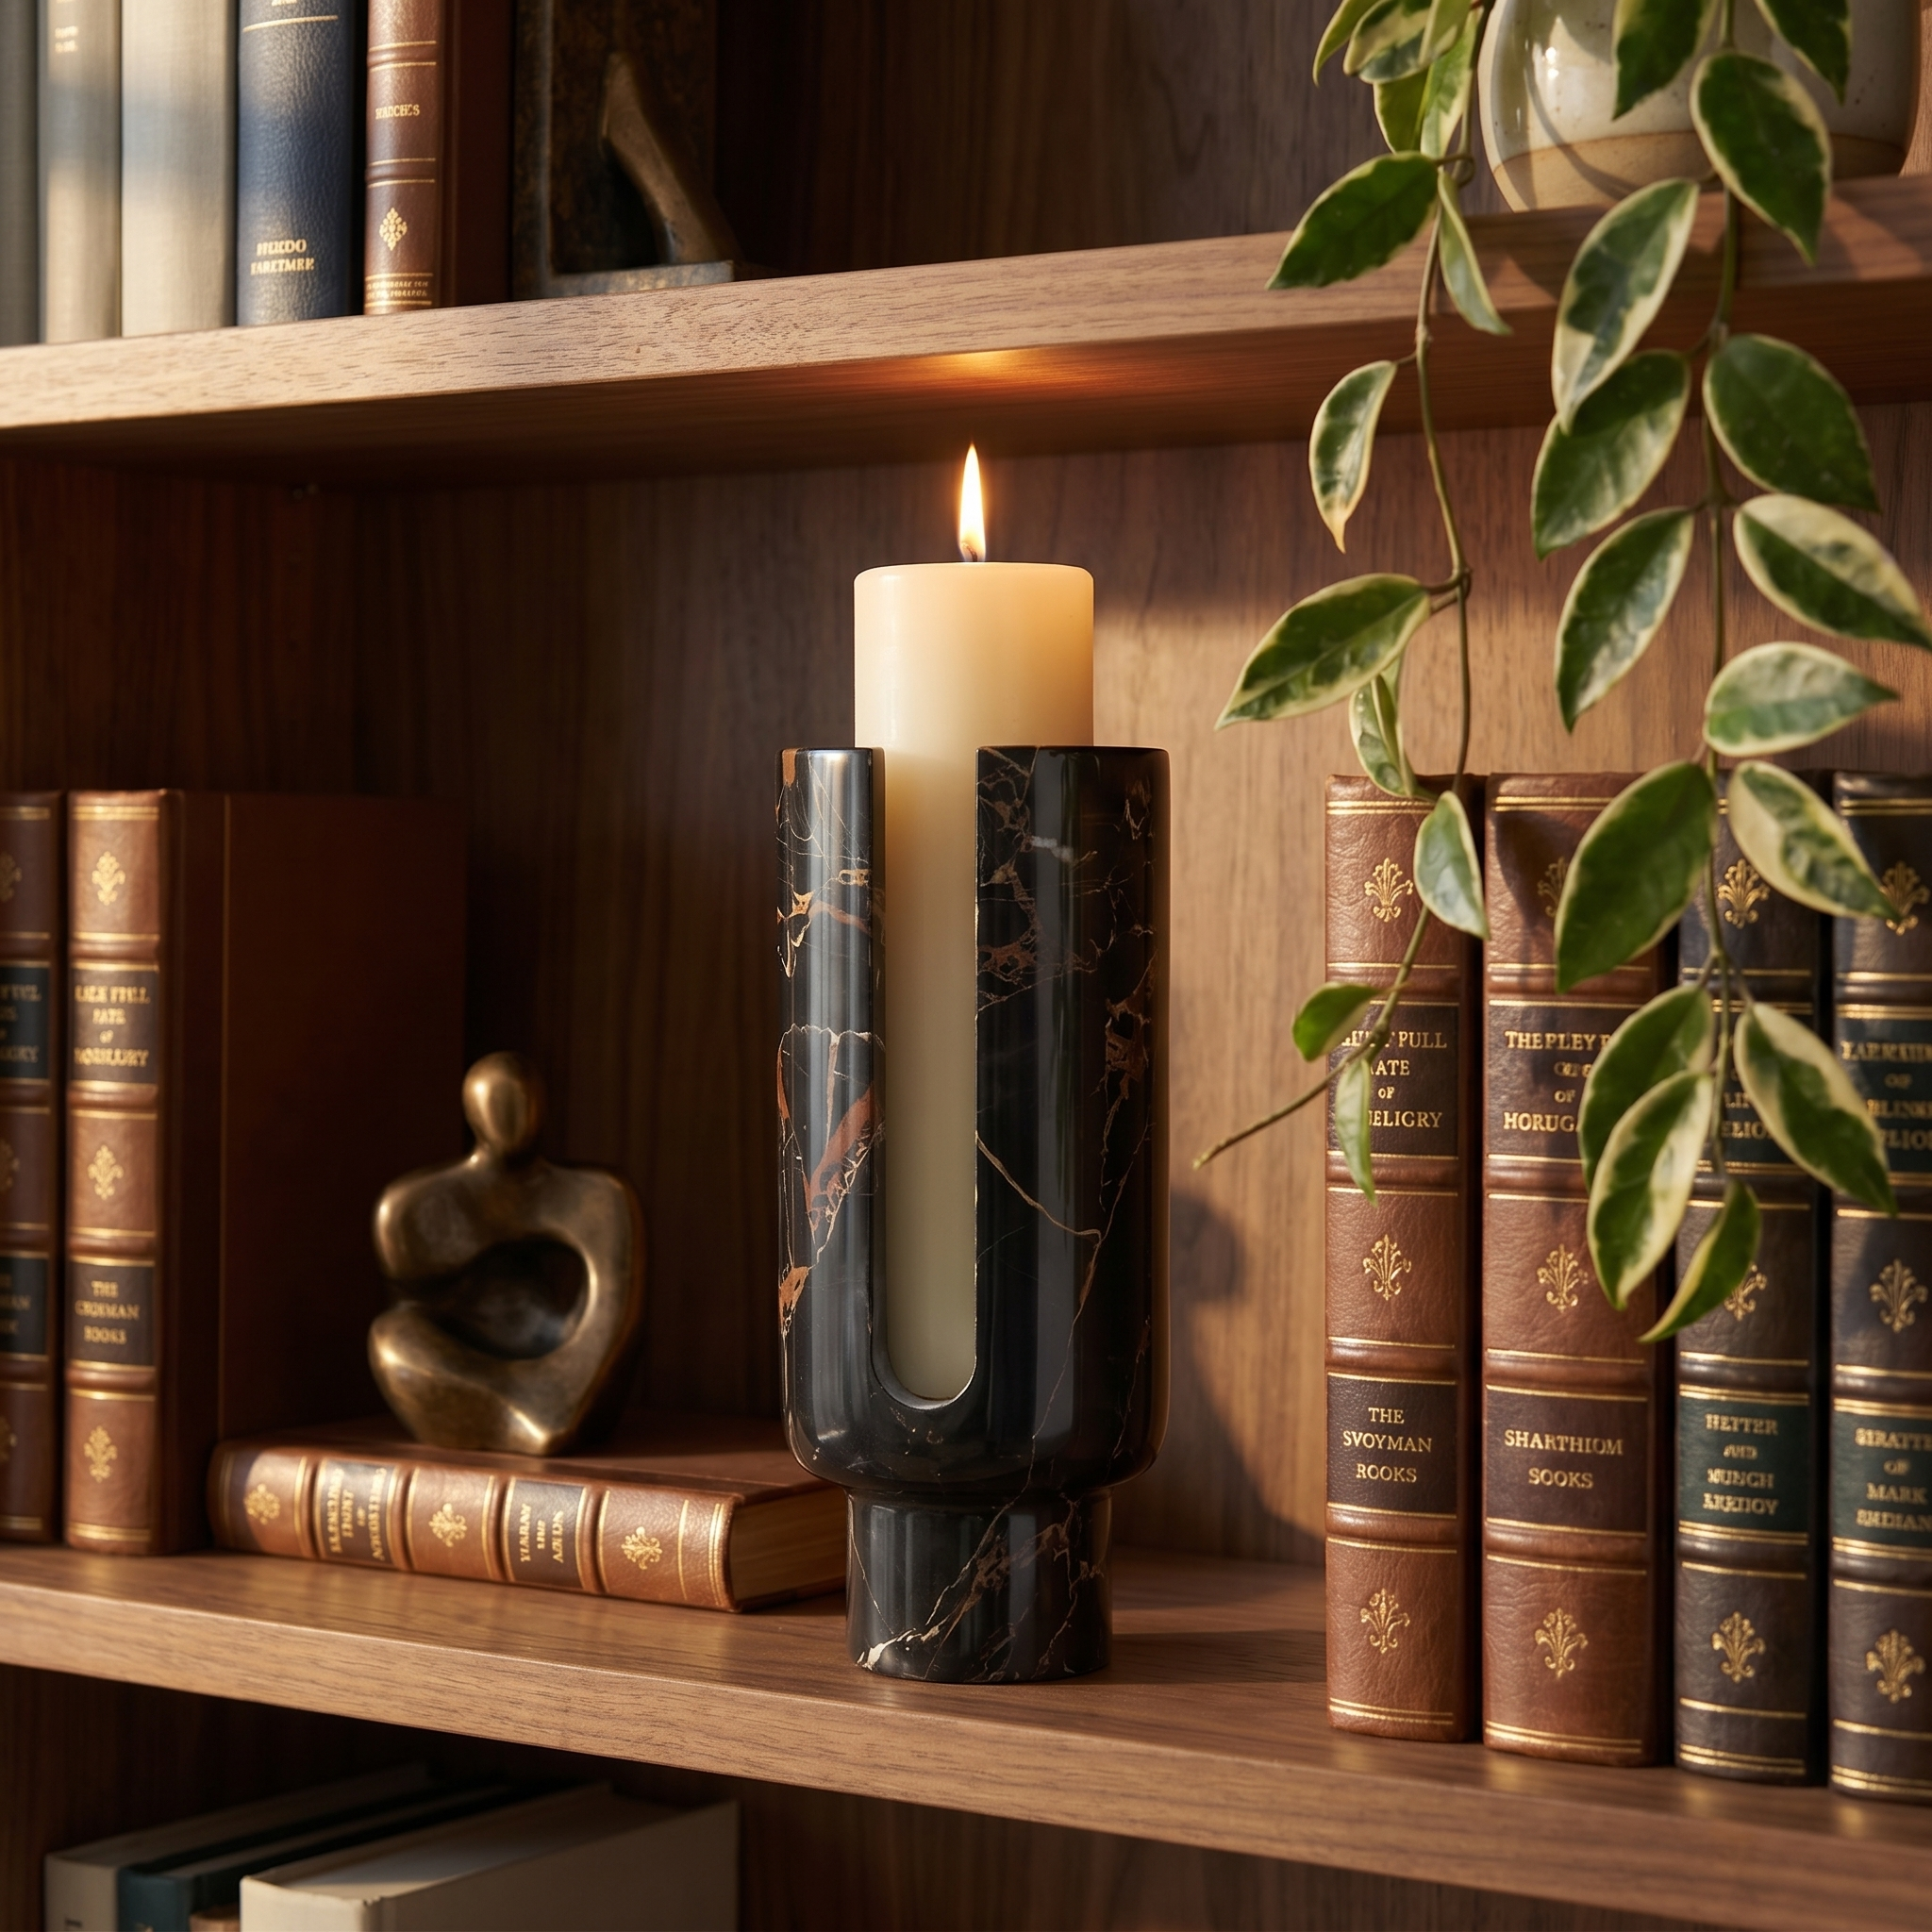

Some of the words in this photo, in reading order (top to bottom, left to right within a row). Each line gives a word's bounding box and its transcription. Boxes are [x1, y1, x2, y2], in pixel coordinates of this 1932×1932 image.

[1398, 1031, 1447, 1048] PULL
[1371, 1059, 1410, 1076] ATE
[1368, 1109, 1442, 1128] ELIGRY
[1503, 1111, 1577, 1132] HORUG
[1368, 1407, 1405, 1424] THE
[1342, 1430, 1432, 1453] SVOYMAN
[1356, 1463, 1417, 1483] ROOKS
[1528, 1467, 1594, 1489] SOOKS
